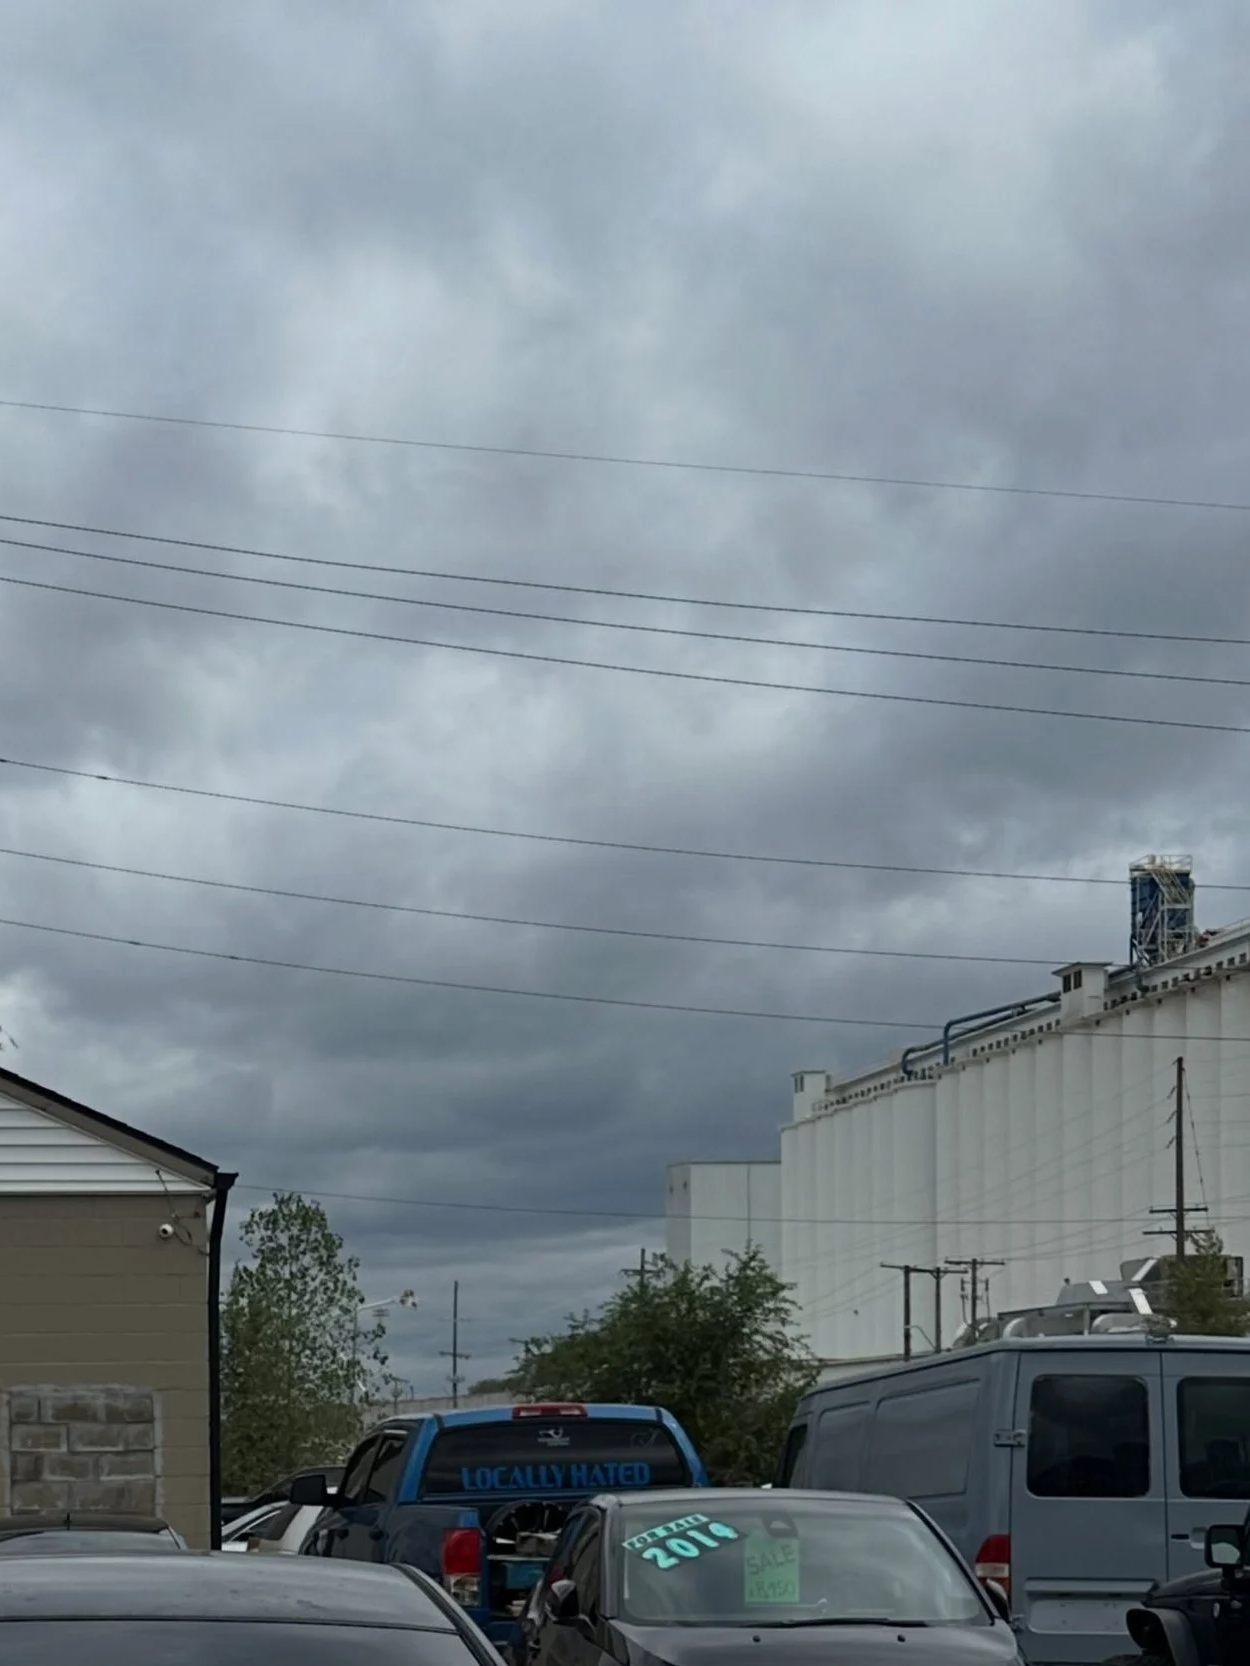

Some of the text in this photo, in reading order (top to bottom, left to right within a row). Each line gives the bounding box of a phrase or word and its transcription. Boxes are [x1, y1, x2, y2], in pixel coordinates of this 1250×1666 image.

[461, 1461, 650, 1490] LOCALLY HATED
[627, 1515, 702, 1549] FOR SALE
[642, 1522, 738, 1569] 2014
[747, 1544, 796, 1576] SALE
